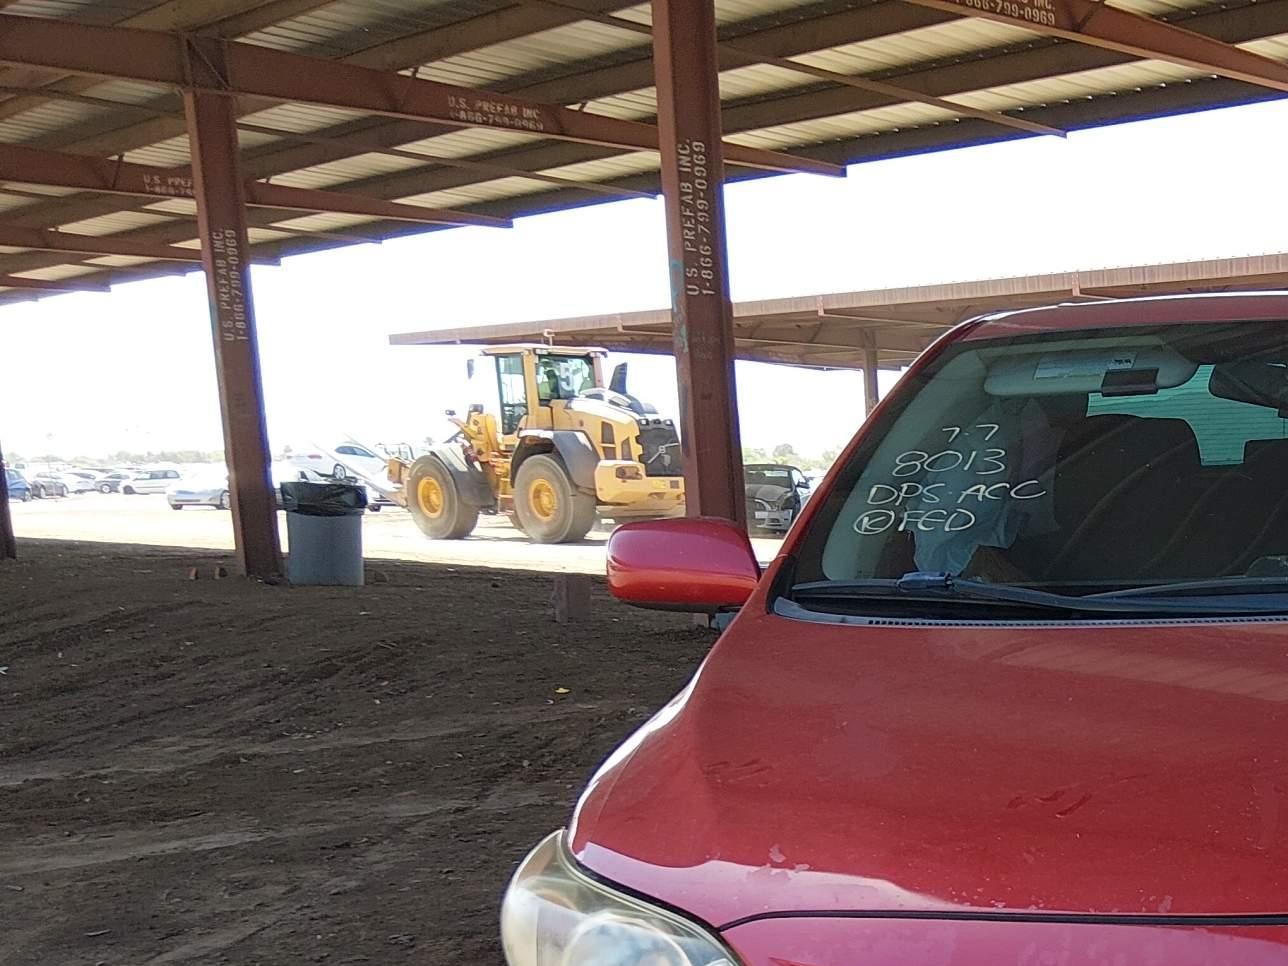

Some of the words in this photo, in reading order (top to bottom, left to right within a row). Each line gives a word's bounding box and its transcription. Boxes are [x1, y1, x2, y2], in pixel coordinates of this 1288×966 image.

[678, 138, 690, 172] INC.
[680, 183, 696, 251] PREFAB
[692, 141, 715, 295] 1-866-799-0969
[216, 259, 231, 309] PREFAB
[892, 449, 1006, 477] 8013
